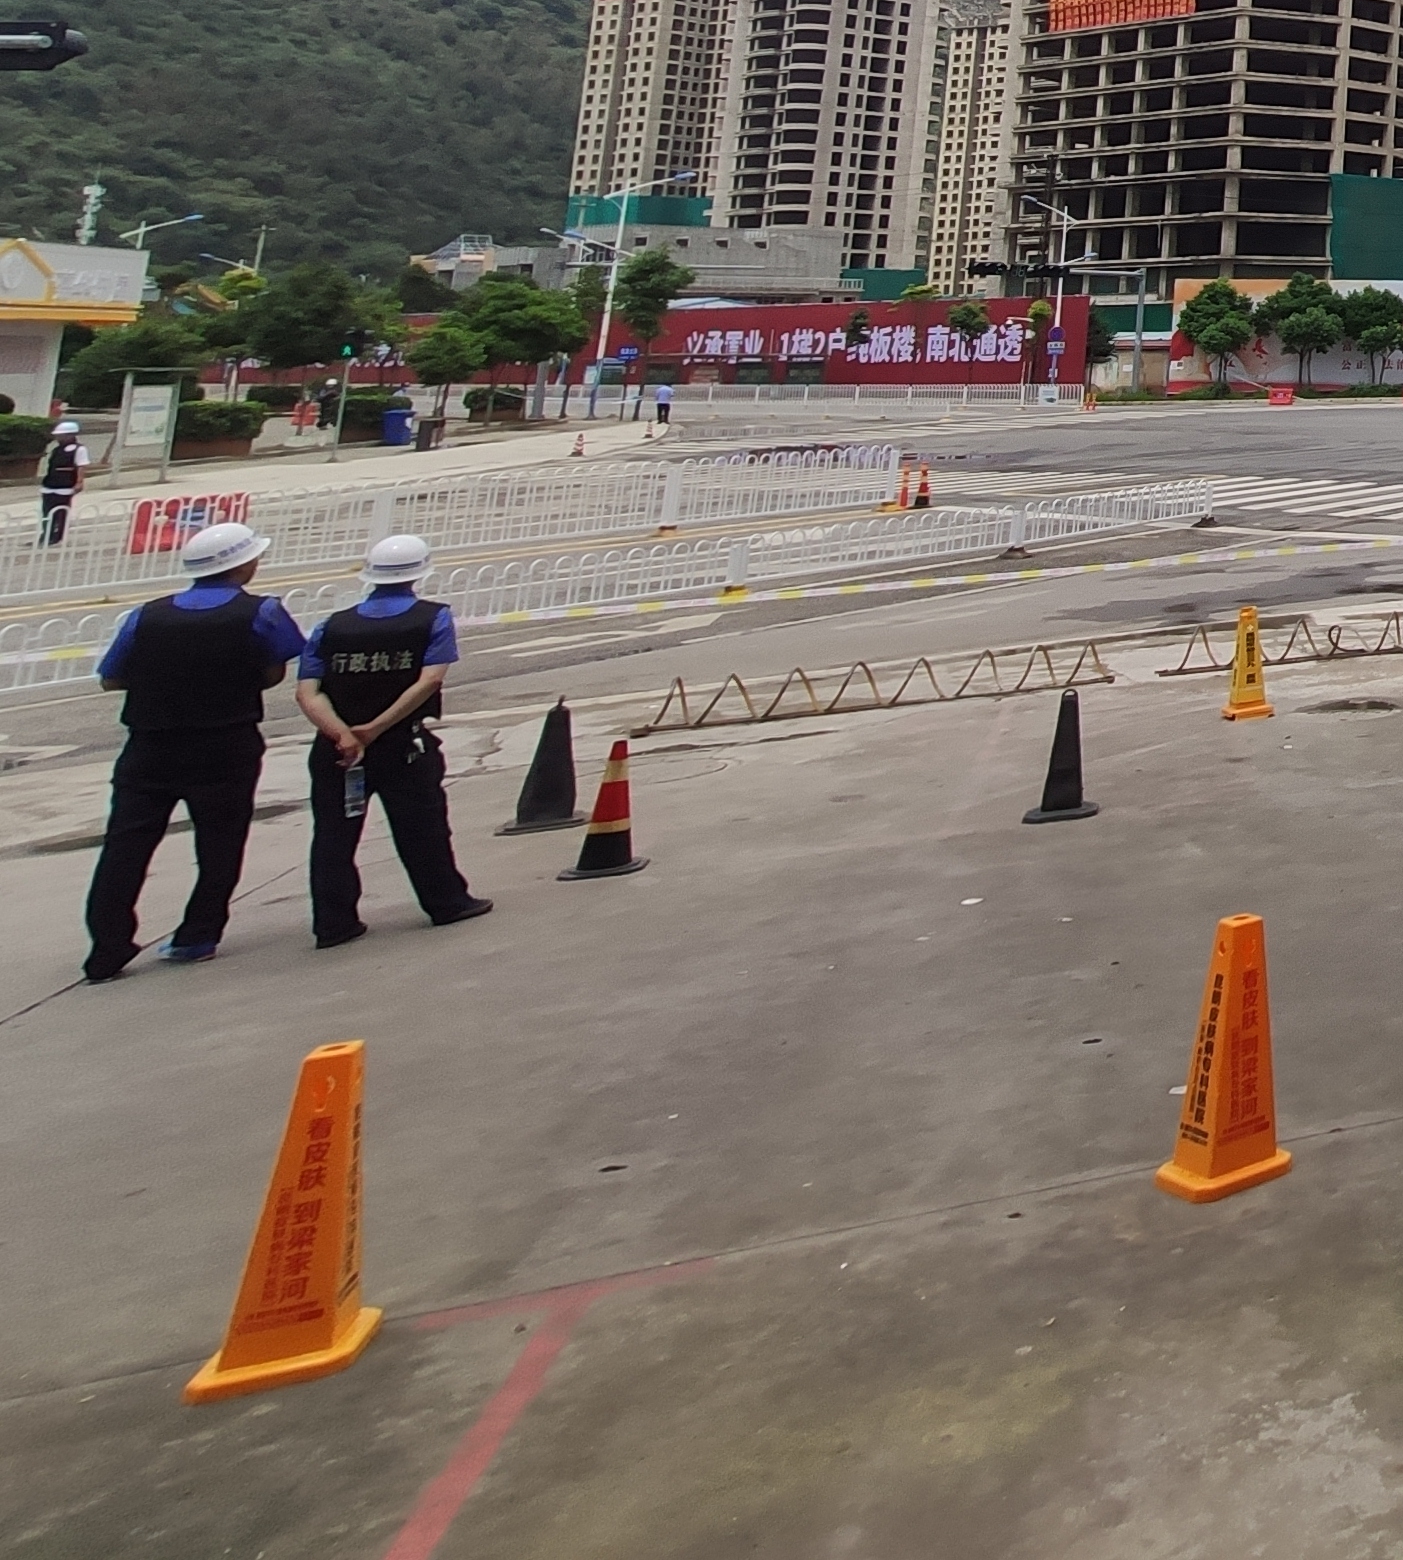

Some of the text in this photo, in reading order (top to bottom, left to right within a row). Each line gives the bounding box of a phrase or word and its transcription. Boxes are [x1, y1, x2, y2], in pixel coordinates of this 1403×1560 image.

[332, 649, 414, 674] 行政执法
[1242, 968, 1260, 1031] 看皮肤
[298, 1115, 335, 1192] 看皮肤
[278, 1198, 323, 1304] 到梁家河
